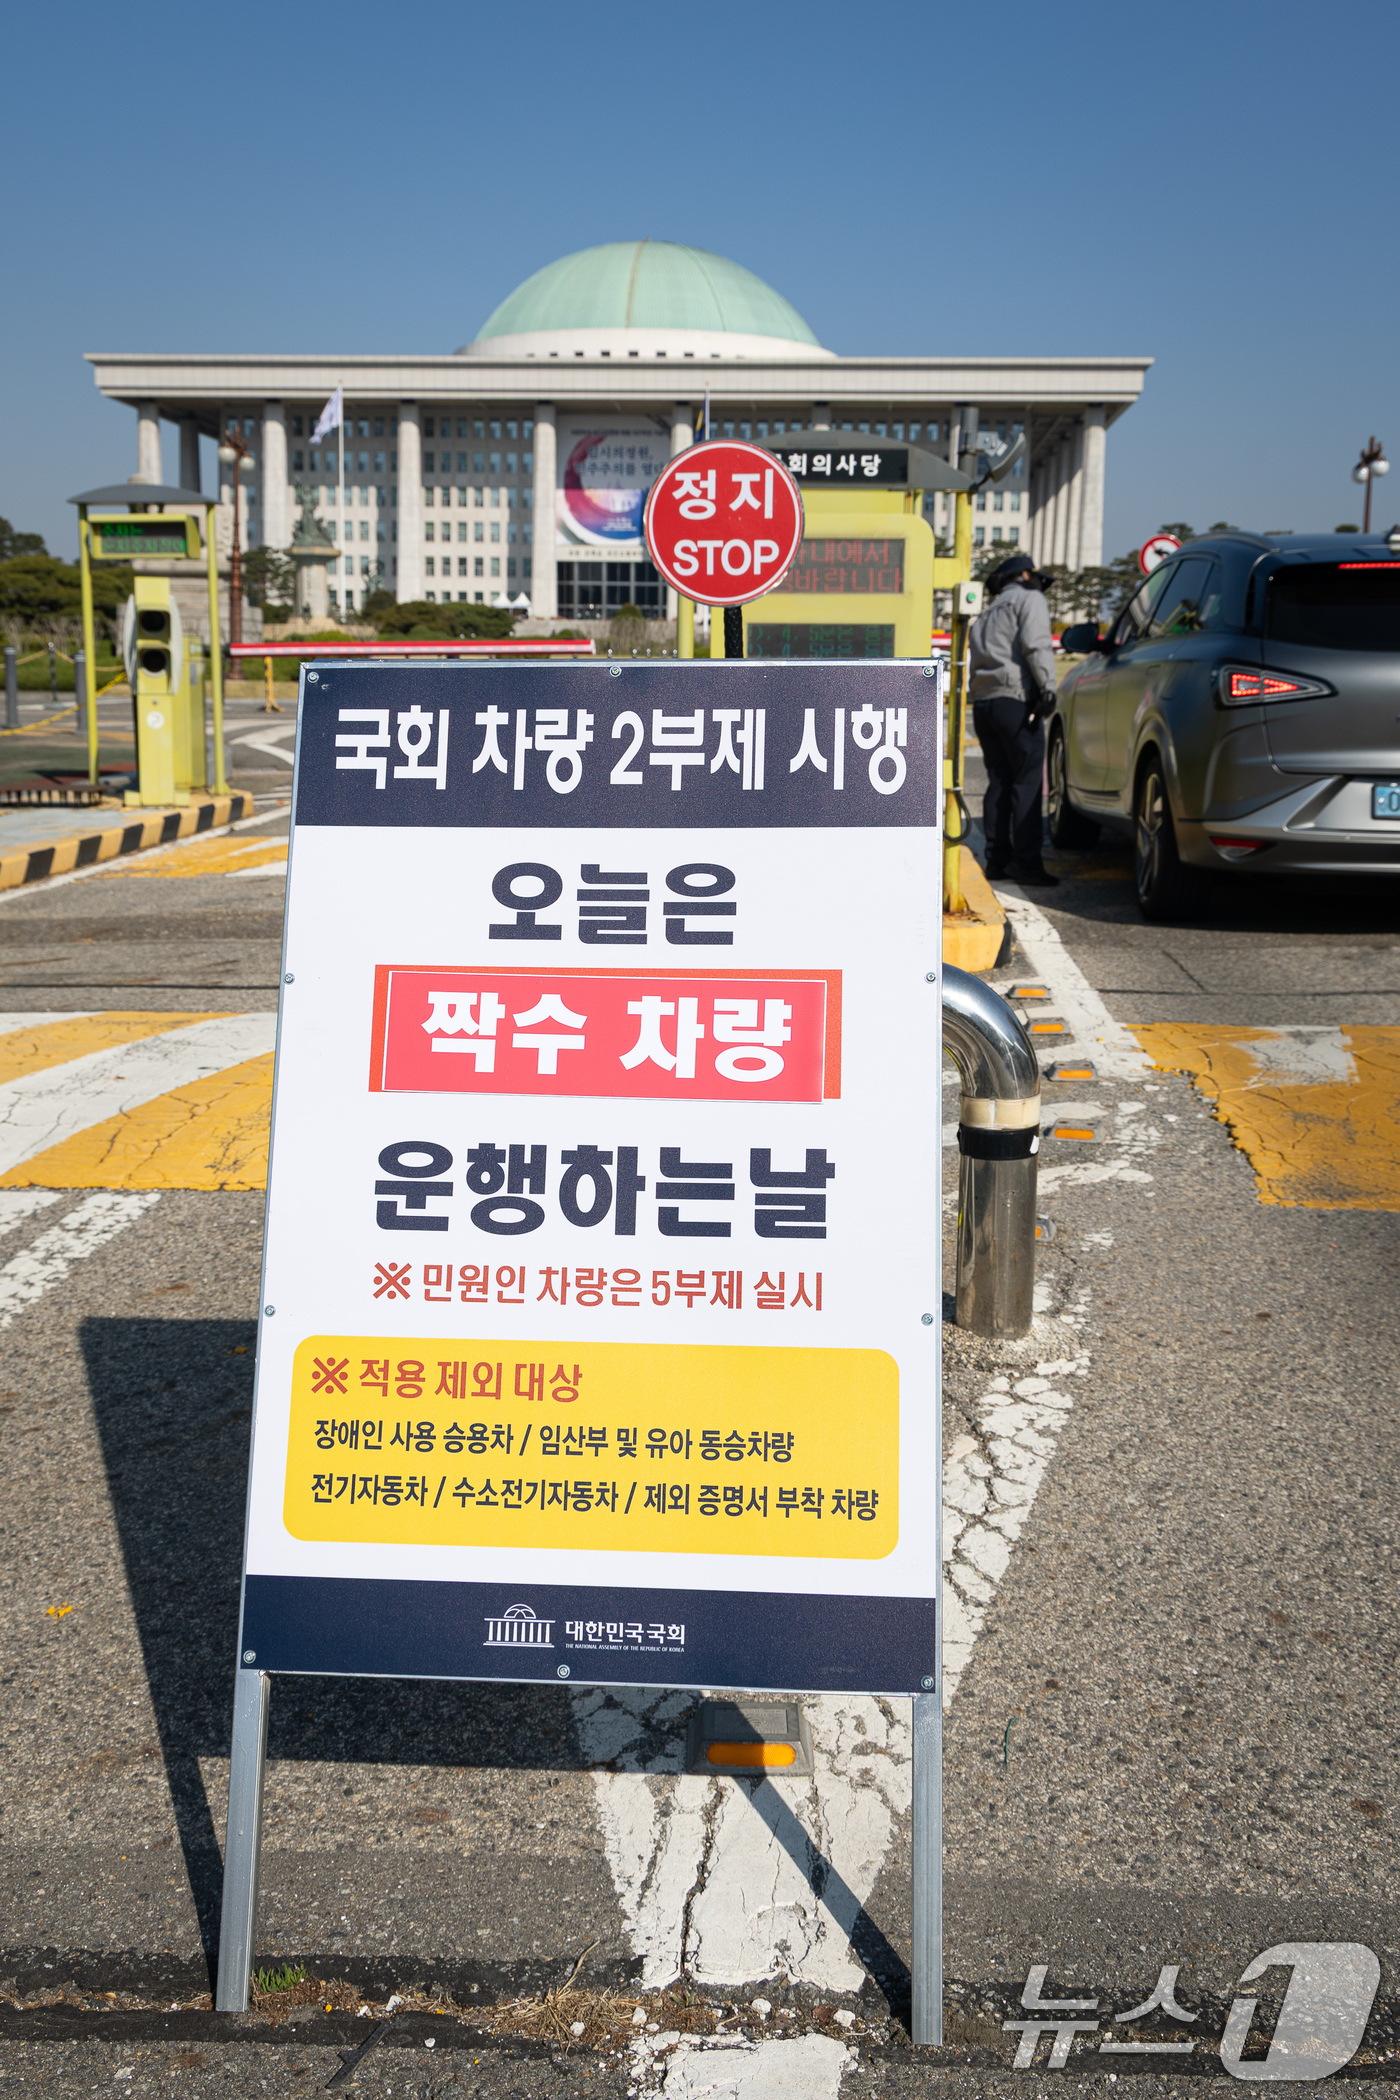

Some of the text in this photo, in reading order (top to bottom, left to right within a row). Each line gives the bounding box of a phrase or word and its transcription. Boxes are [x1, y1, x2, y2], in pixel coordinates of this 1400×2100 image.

[776, 453, 882, 477] 회의사당
[672, 469, 774, 520] 정지
[672, 539, 780, 576] STOP
[335, 704, 907, 795] 국회 차량 2부제 시행
[489, 863, 736, 944] 오늘은
[421, 991, 792, 1082] 짝수 차량
[424, 1265, 525, 1303] 민원인
[754, 1272, 821, 1310] 실시
[360, 1360, 425, 1398] 적용
[436, 1362, 502, 1399] 제외
[515, 1364, 582, 1402] 대상
[315, 1419, 382, 1449] 장애인
[390, 1421, 436, 1452] 사용
[443, 1423, 513, 1454] 승용차
[540, 1426, 608, 1456] 임산부
[617, 1428, 637, 1458] 및
[646, 1429, 692, 1459] 유아
[699, 1430, 794, 1462] 동승차량
[312, 1473, 428, 1506] 전기자동차
[453, 1477, 618, 1512] 수소전기자동차
[644, 1483, 689, 1514] 제외
[698, 1485, 767, 1517] 증명서
[776, 1487, 824, 1519] 부착
[831, 1489, 878, 1520] 차량
